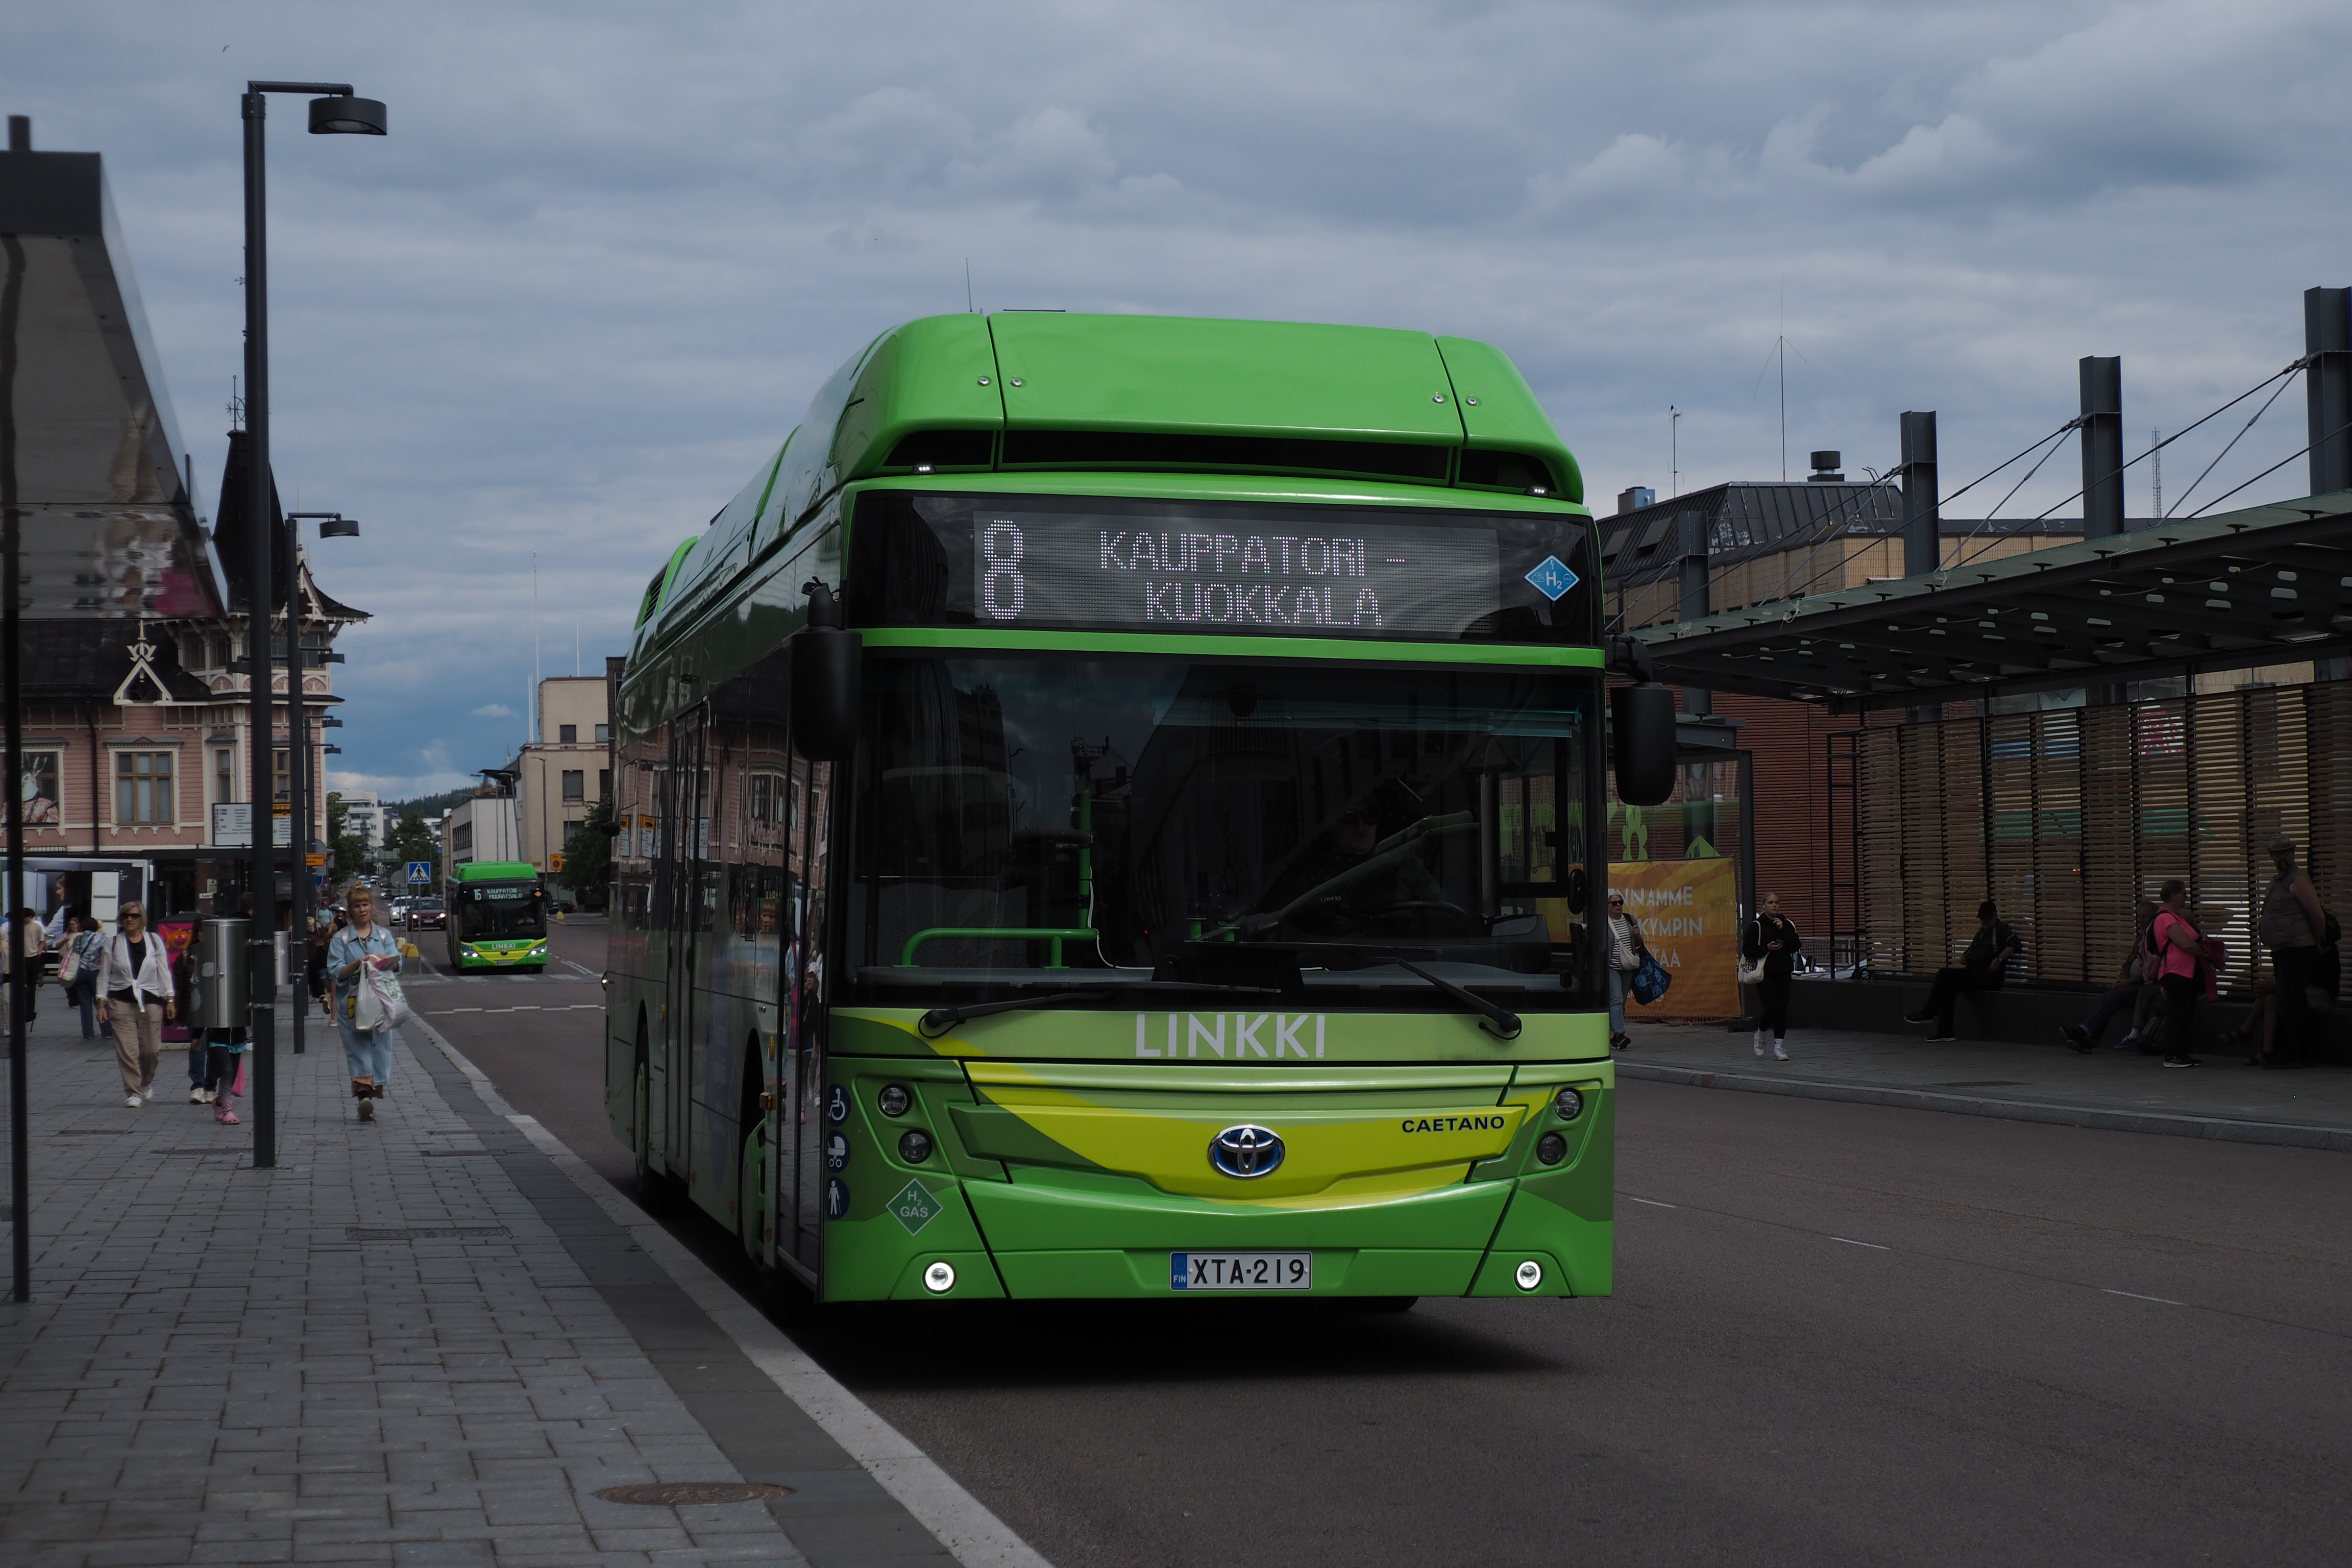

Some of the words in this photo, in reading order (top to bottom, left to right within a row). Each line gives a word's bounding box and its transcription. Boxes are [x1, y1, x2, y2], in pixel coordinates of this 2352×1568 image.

[1101, 531, 1365, 576] KAUPPATORI
[984, 520, 1024, 620] 8
[1146, 582, 1382, 626] KUOKKALA
[474, 888, 482, 901] 16
[1136, 1013, 1325, 1058] LINKKI
[1402, 1116, 1505, 1133] CAETANO
[900, 1206, 928, 1218] GAS
[1173, 1275, 1187, 1283] FIN
[1193, 1259, 1305, 1284] XTA-219
